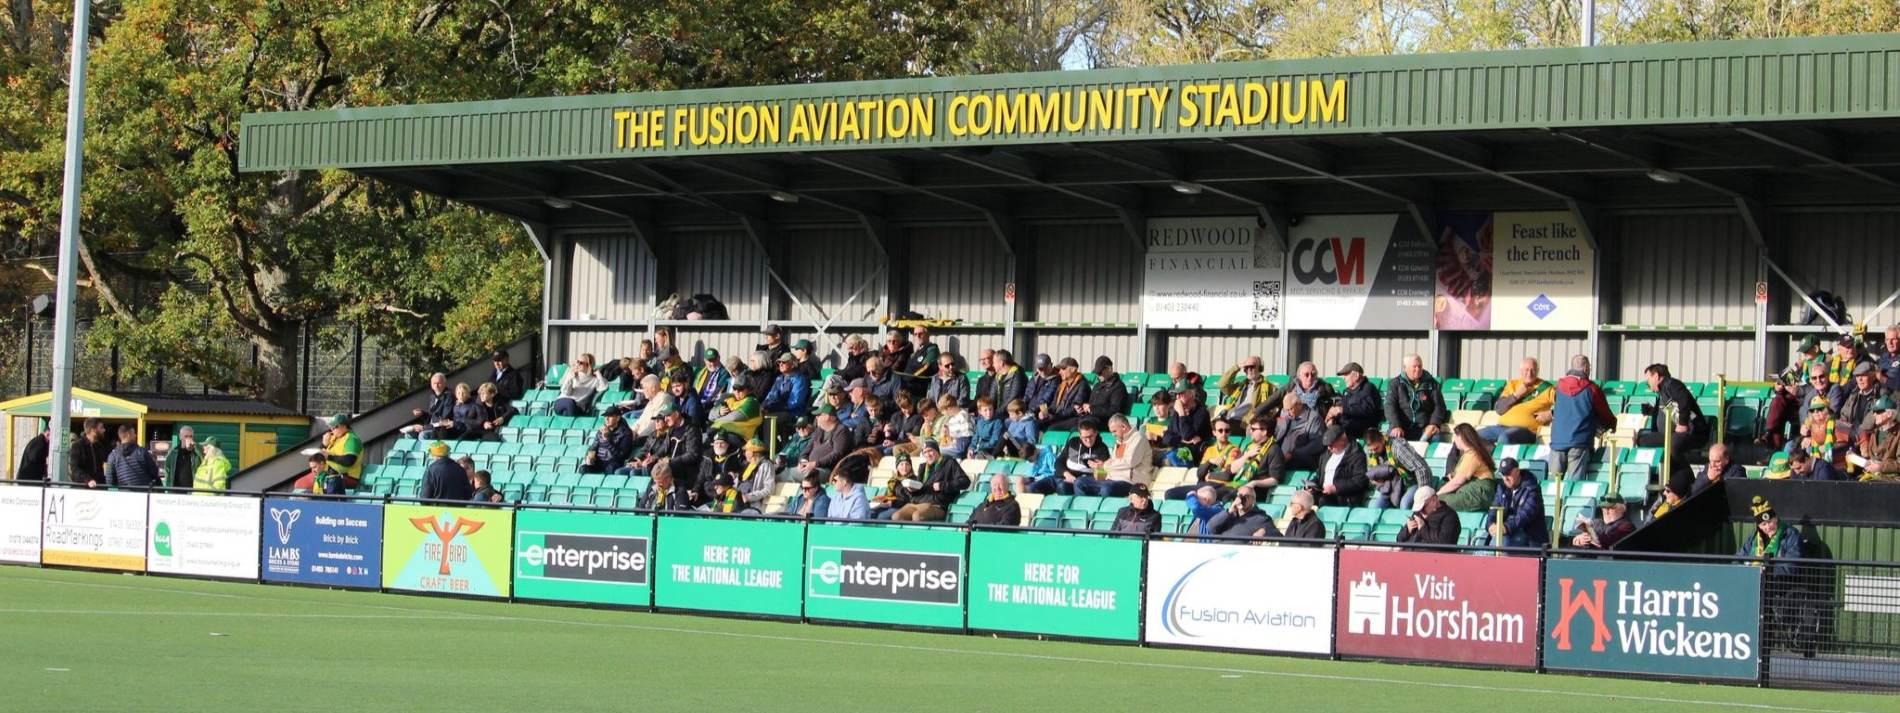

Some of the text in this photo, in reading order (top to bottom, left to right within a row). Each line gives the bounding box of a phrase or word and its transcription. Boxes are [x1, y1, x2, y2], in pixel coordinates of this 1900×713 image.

[613, 79, 1346, 148] THE FUSION AVIATION COMMUNITY STADIUM
[1150, 227, 1250, 246] REDWOOD
[1512, 222, 1577, 239] Feast like
[1150, 257, 1248, 270] FINANCIAL
[1507, 244, 1580, 262] the French
[47, 494, 65, 524] A1
[46, 526, 104, 551] RoadMarkings
[269, 546, 300, 561] LAMBS
[424, 543, 467, 563] FIRE BIRD
[525, 544, 645, 575] enterprise
[703, 545, 751, 566] HERE FOR
[420, 576, 469, 591] CRAFT BEER
[672, 564, 782, 589] THE NATIONAL LEAGUE
[819, 561, 957, 593] enterprise
[1024, 563, 1080, 585] HERE FOR
[987, 583, 1010, 603] THE
[1415, 573, 1456, 601] Visit
[1618, 580, 1719, 619] Harris
[1179, 605, 1316, 629] Fusion Aviation
[1391, 596, 1524, 643] Horsham
[1616, 620, 1751, 660] Wickens
